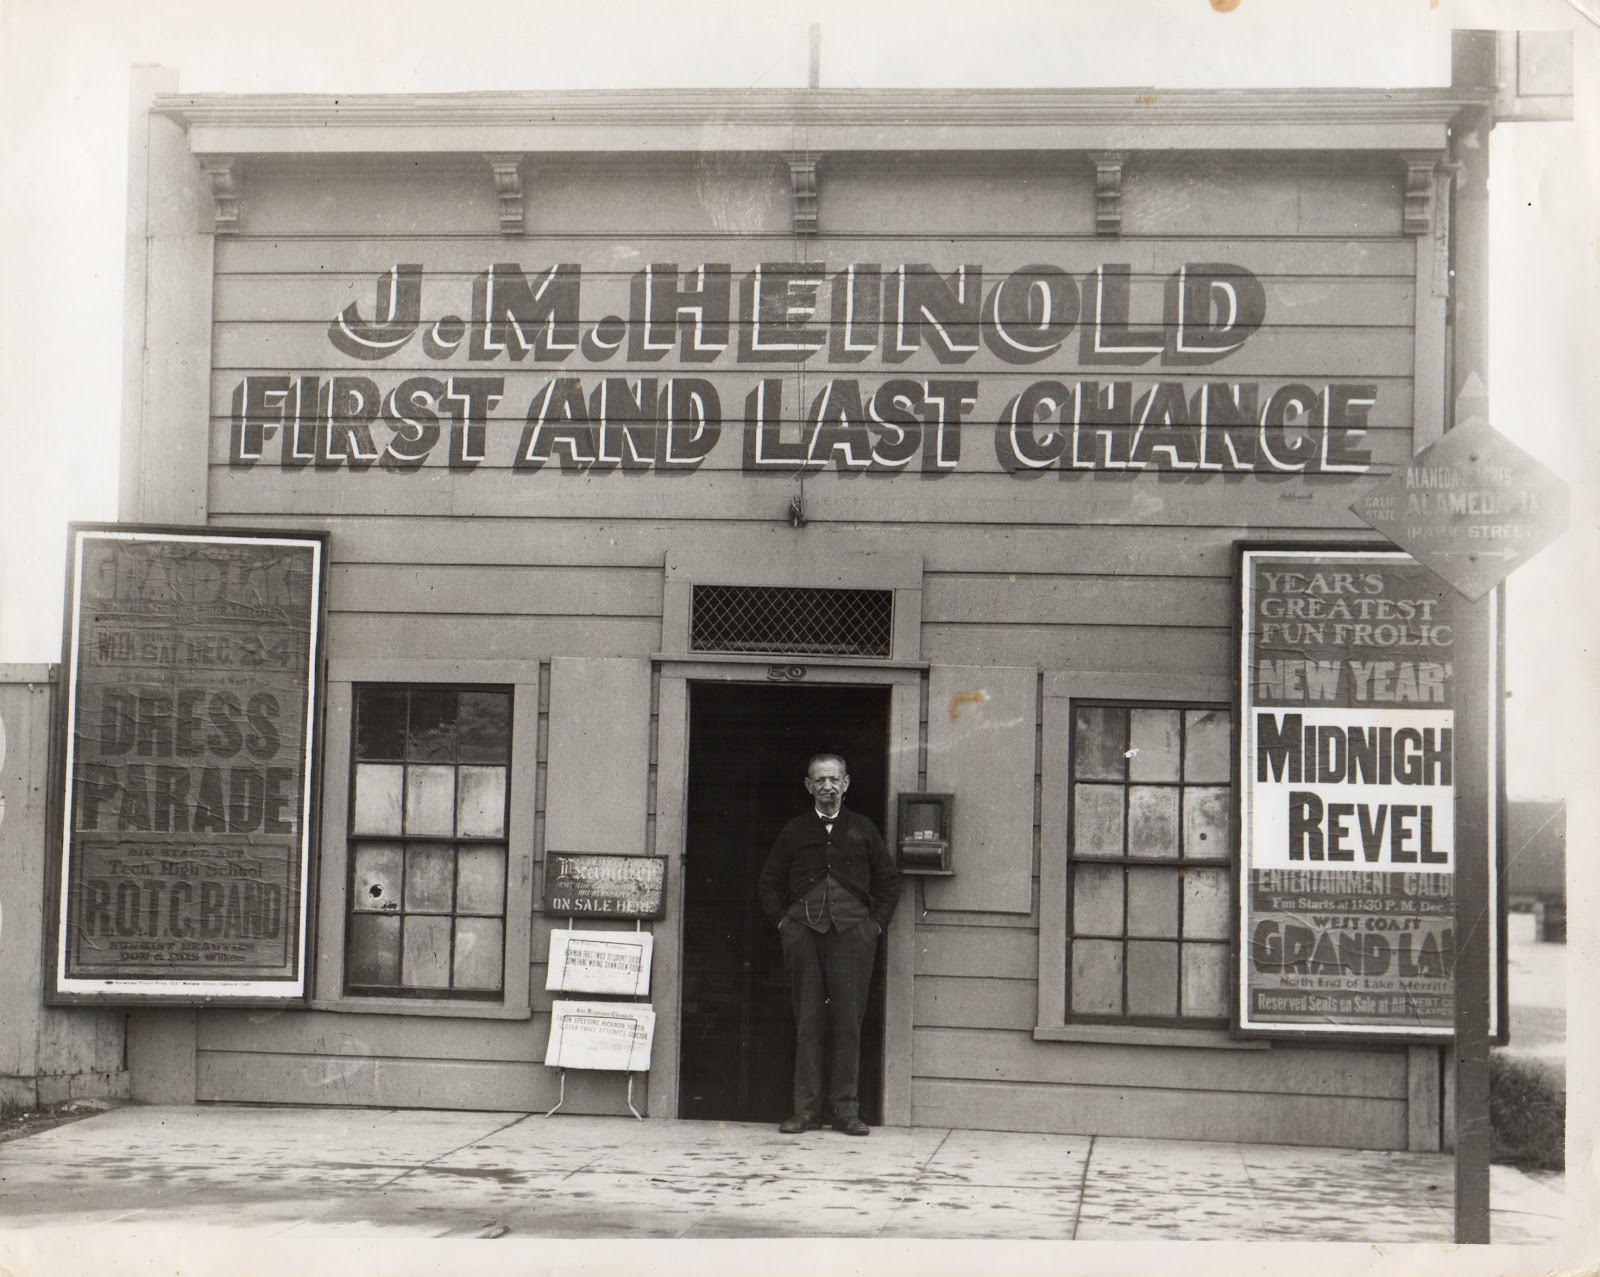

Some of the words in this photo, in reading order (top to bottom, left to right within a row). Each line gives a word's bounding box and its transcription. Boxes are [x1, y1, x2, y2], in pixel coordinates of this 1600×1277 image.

[229, 376, 505, 474] FIRST
[512, 378, 722, 477] AND
[742, 378, 978, 482] LAST
[994, 381, 1376, 485] CHANCE
[1408, 491, 1504, 515] ALAMED
[1261, 572, 1384, 594] YEAR'S
[1260, 598, 1437, 620] GREATEST
[1260, 623, 1325, 644] FUN
[1334, 624, 1453, 646] FROLIC
[1258, 660, 1341, 701] NEW
[1350, 661, 1453, 702] YEAR'
[101, 687, 281, 760] DRESS
[1257, 713, 1452, 786] MIDNIGH
[82, 765, 294, 834] PARADE
[1289, 791, 1448, 864] REVEL
[1259, 869, 1391, 895] ENTERTAINMENT
[1403, 871, 1453, 896] GALO
[553, 897, 571, 910] ON
[574, 898, 612, 912] SALE
[1299, 898, 1335, 911] Starts
[1312, 916, 1360, 930] WEST
[1365, 917, 1422, 932] COAST
[1252, 919, 1392, 977] GRAND
[1280, 977, 1316, 988] North
[1318, 978, 1342, 988] End
[1346, 978, 1359, 989] of
[1364, 978, 1394, 990] Lake
[1258, 993, 1306, 1011] Reserved
[574, 1015, 600, 1026] SPEEDING
